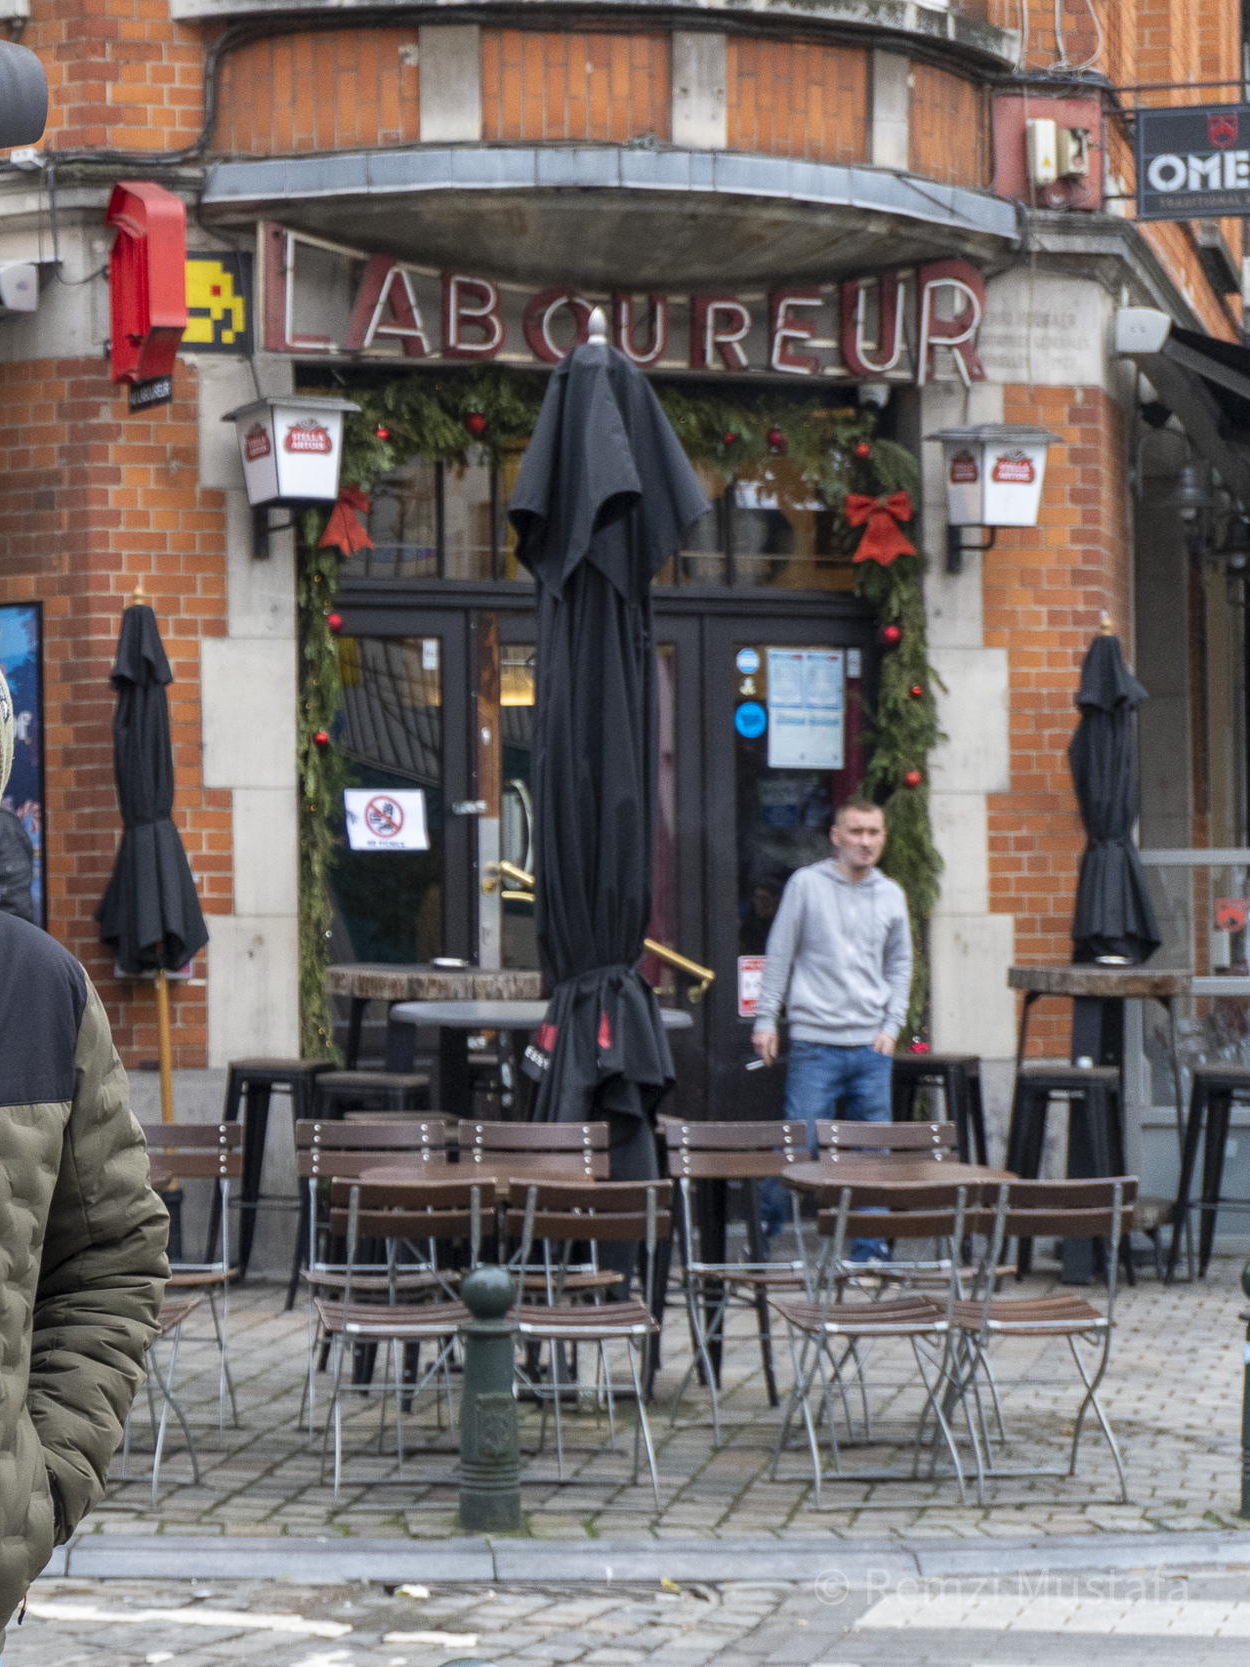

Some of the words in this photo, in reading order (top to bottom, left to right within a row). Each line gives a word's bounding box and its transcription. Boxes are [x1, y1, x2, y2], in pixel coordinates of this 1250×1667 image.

[264, 222, 988, 387] LABOUREUR
[291, 431, 325, 443] STELLA
[291, 441, 326, 451] ARTOIS
